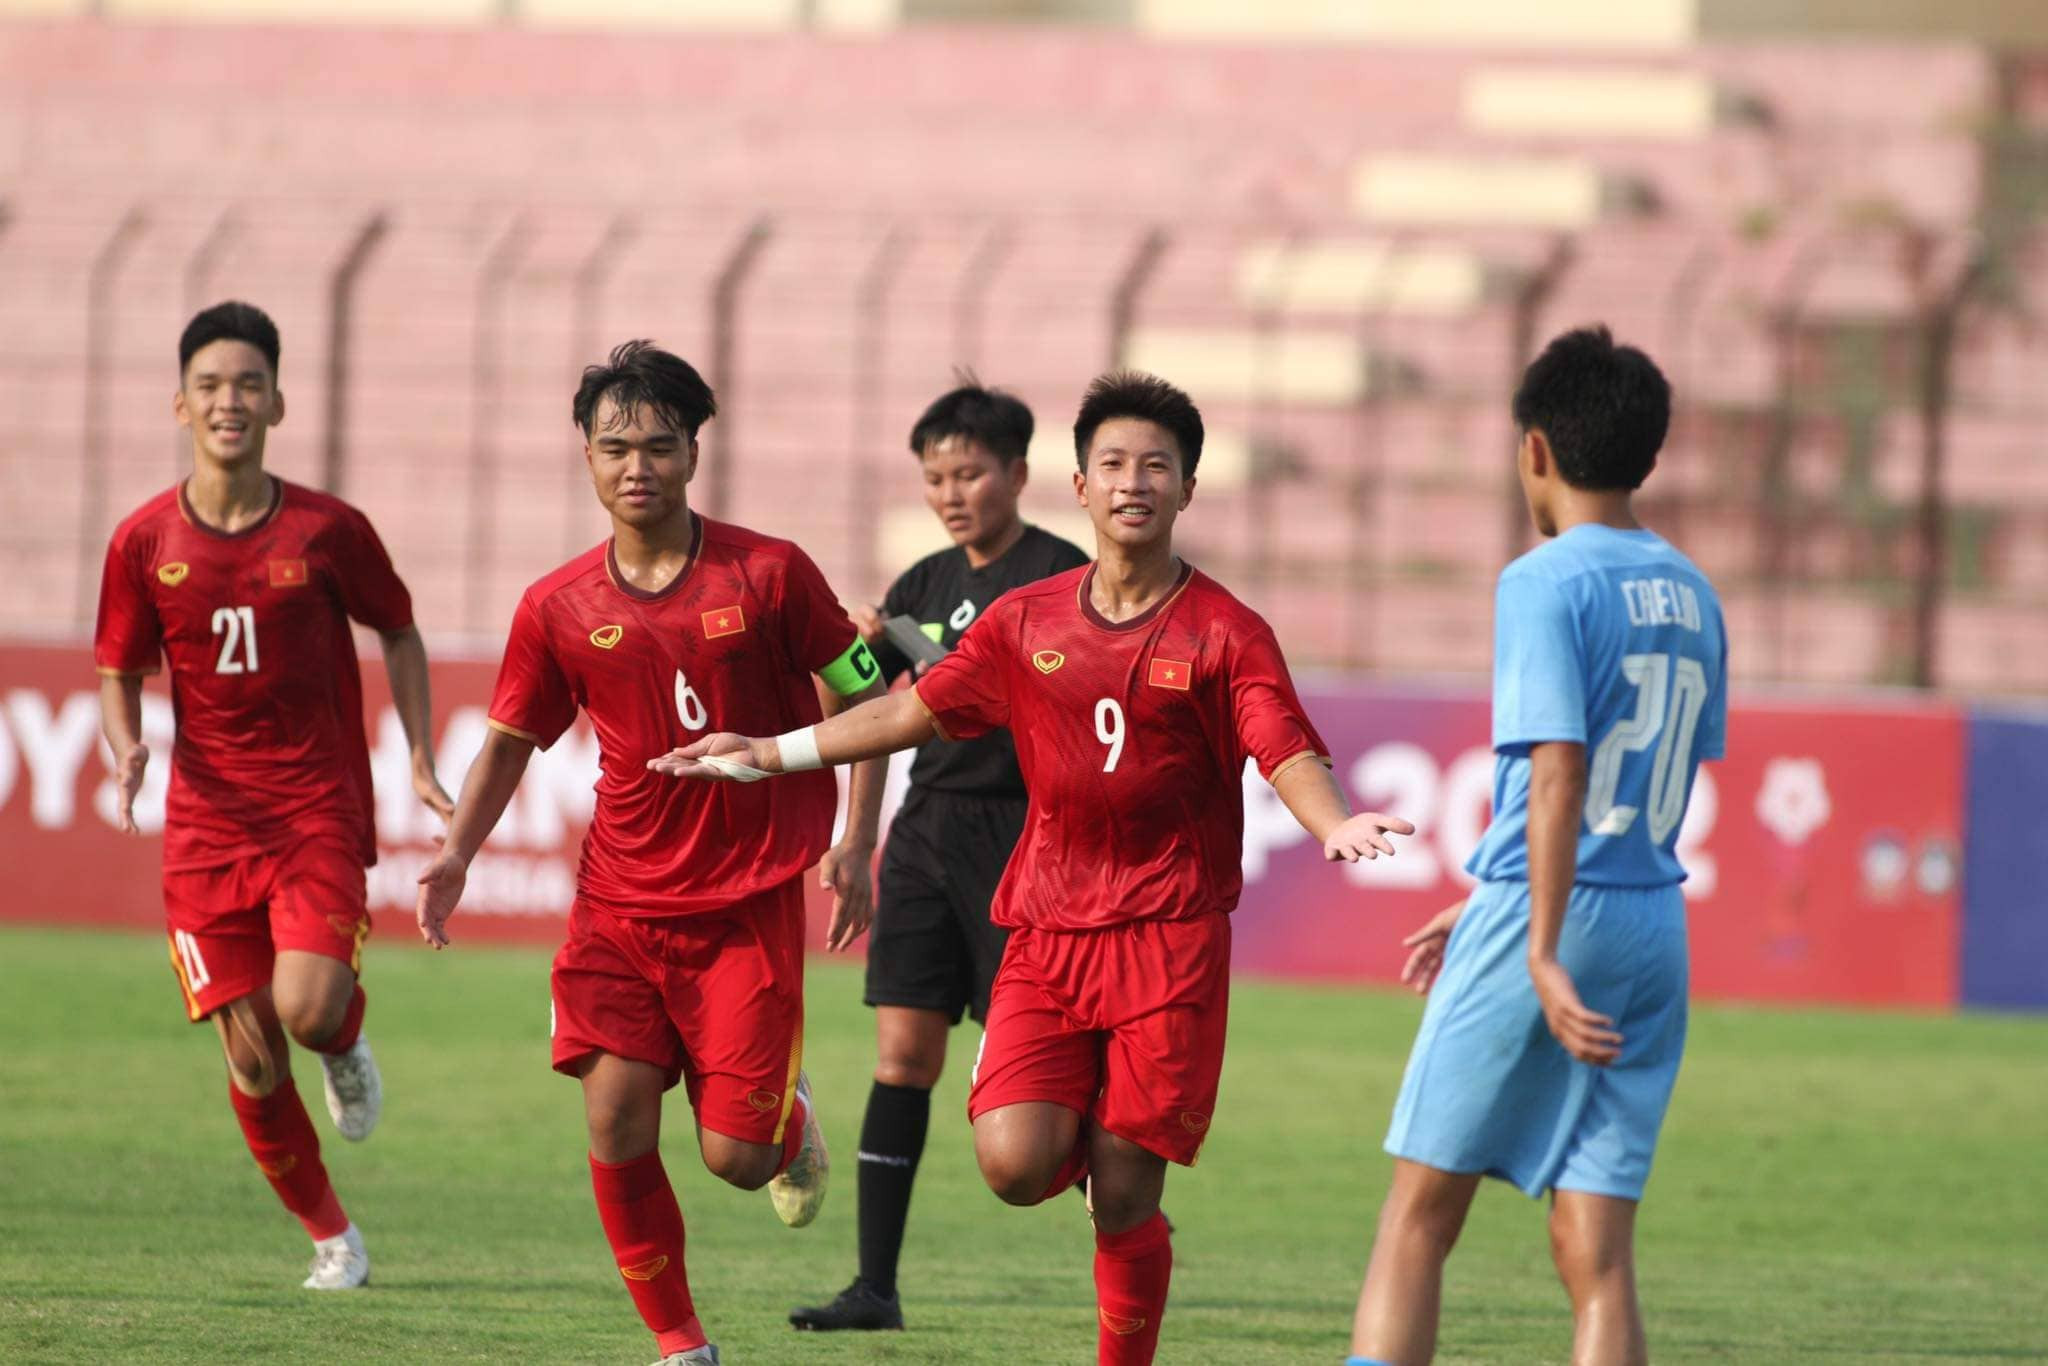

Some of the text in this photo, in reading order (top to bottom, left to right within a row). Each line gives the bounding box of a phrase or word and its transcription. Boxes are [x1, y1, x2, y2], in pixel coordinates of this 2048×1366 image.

[211, 606, 258, 674] 21
[850, 643, 876, 681] C
[675, 668, 707, 730] 6
[1094, 697, 1125, 772] 9
[1585, 653, 1707, 845] 20
[175, 928, 211, 993] 21
